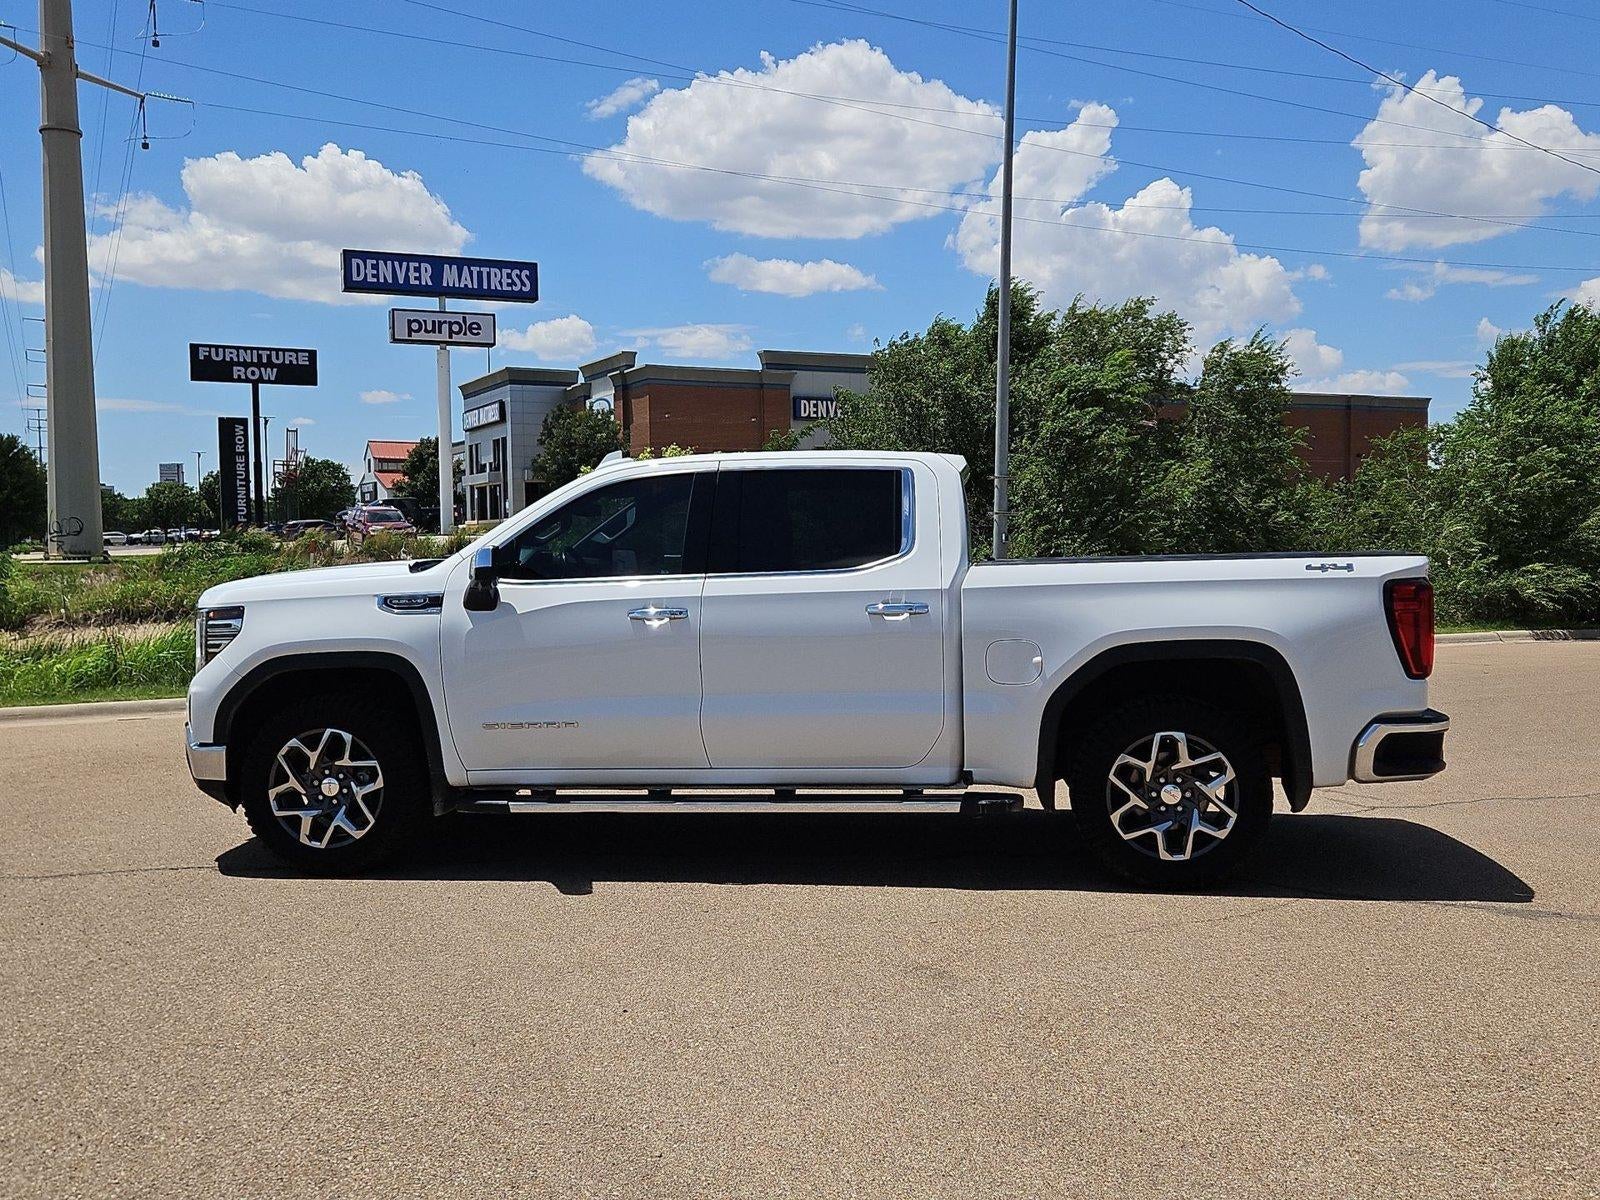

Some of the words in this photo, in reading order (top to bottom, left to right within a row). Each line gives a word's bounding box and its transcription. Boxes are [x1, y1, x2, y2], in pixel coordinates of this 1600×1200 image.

[351, 257, 433, 286] DENVER
[442, 264, 531, 292] MATTRESS
[406, 315, 482, 339] purple
[198, 346, 310, 365] FURNITURE
[232, 366, 278, 381] ROW
[234, 424, 245, 452] ROW
[235, 455, 248, 522] FURNITURE
[482, 721, 579, 730] SIERRA
